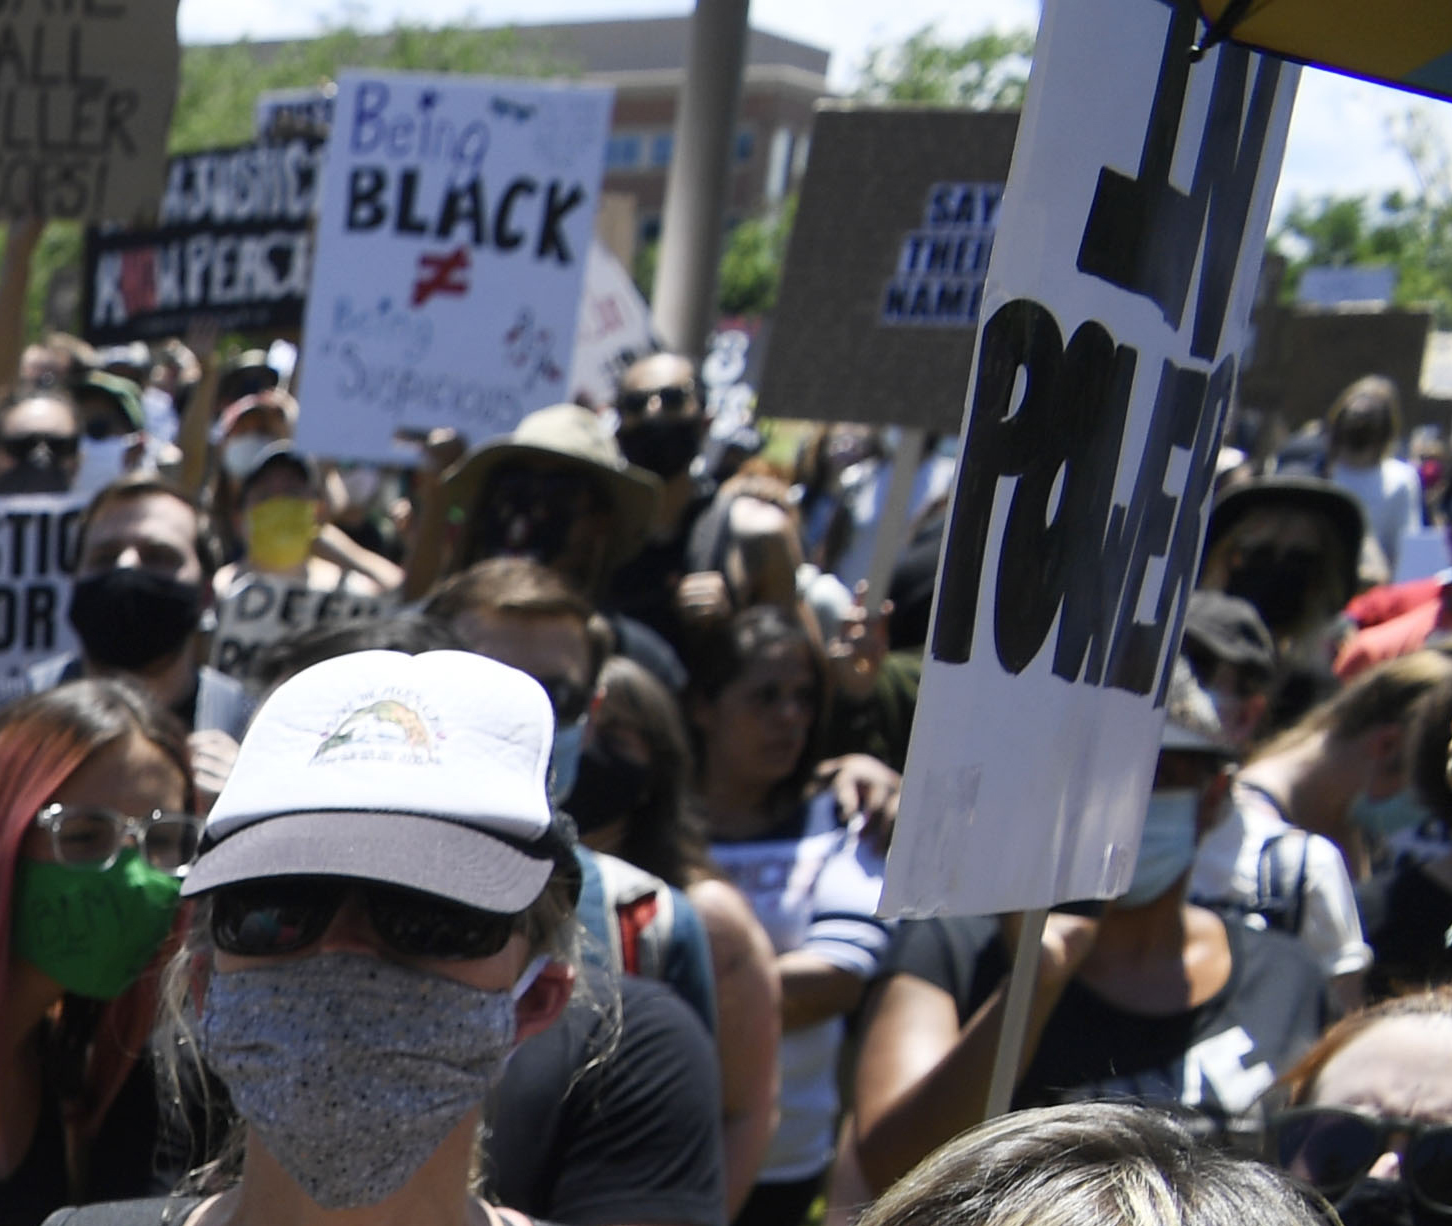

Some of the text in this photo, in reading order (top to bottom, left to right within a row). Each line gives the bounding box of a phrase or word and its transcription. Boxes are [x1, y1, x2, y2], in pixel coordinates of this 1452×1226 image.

[350, 80, 493, 184] Being
[344, 163, 587, 270] BLACK
[928, 184, 1003, 223] SAY
